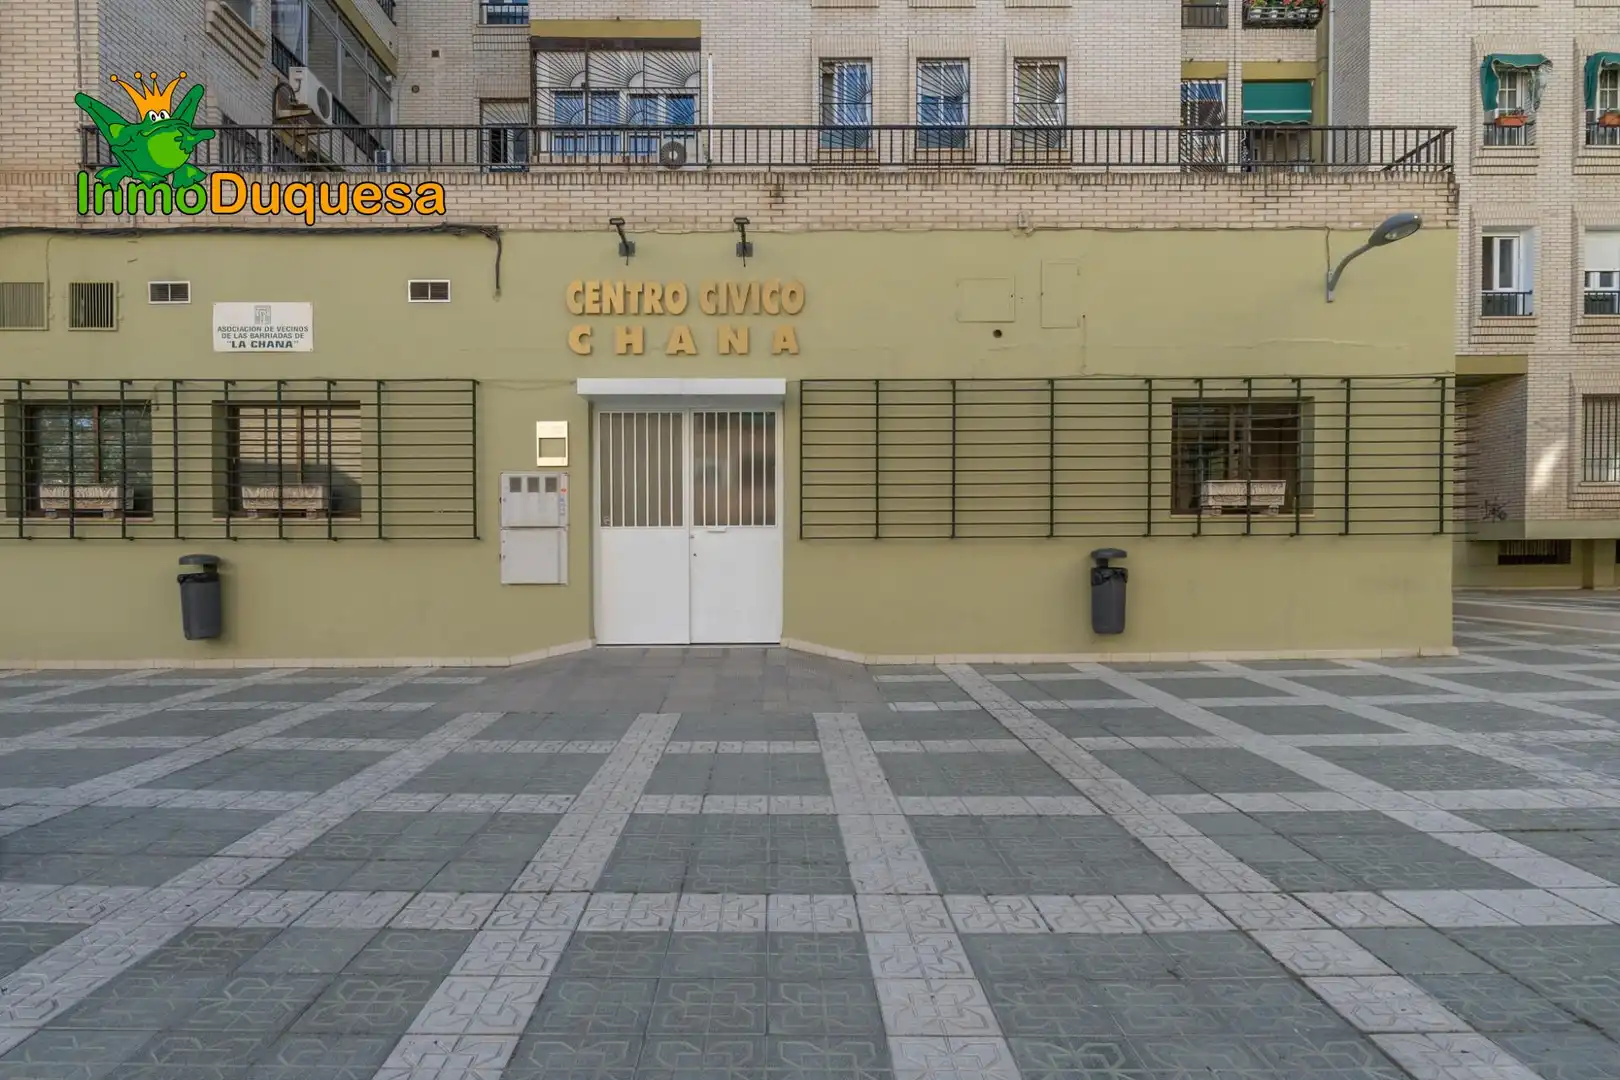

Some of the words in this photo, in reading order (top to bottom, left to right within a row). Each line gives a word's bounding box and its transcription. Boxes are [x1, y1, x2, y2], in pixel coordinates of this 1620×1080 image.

[566, 279, 688, 316] CENTRO
[700, 279, 806, 316] CIVICO
[568, 324, 799, 355] CHANA
